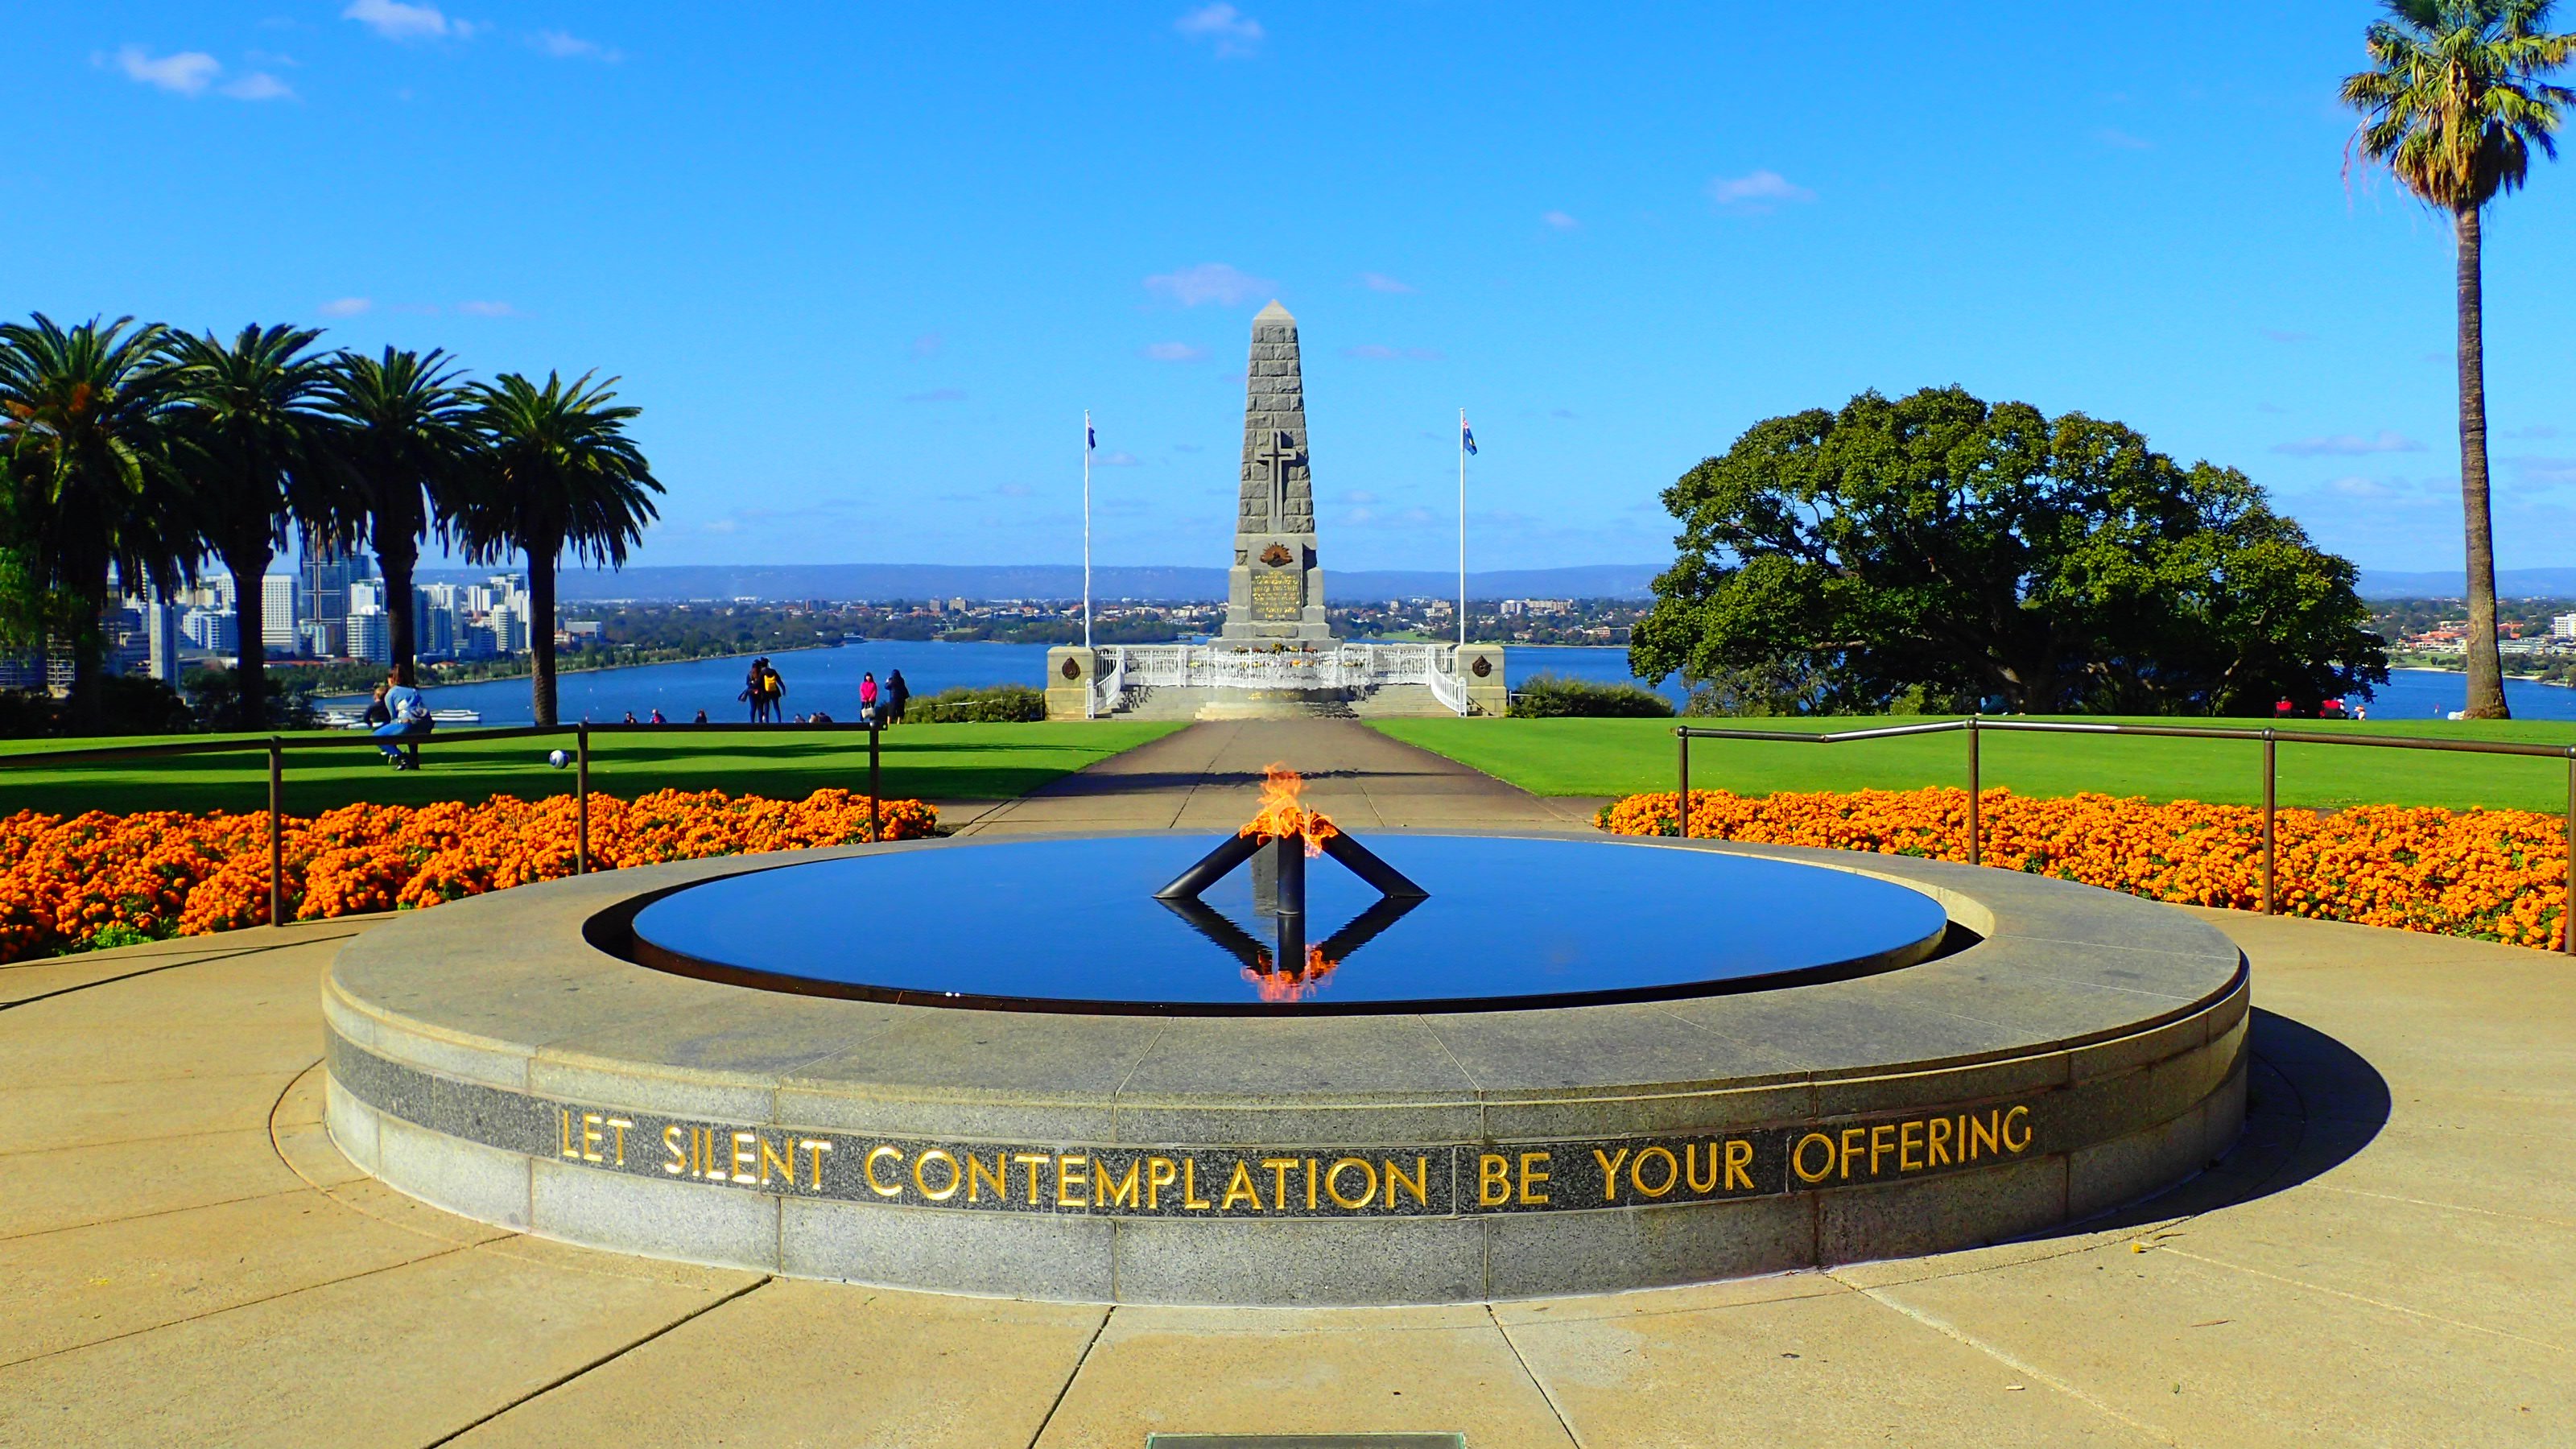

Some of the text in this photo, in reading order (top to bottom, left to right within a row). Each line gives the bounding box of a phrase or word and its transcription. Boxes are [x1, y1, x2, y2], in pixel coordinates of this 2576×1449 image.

[561, 1105, 2033, 1210] LET SILENT CONTEMPLATION BE YOUR OFFERING
